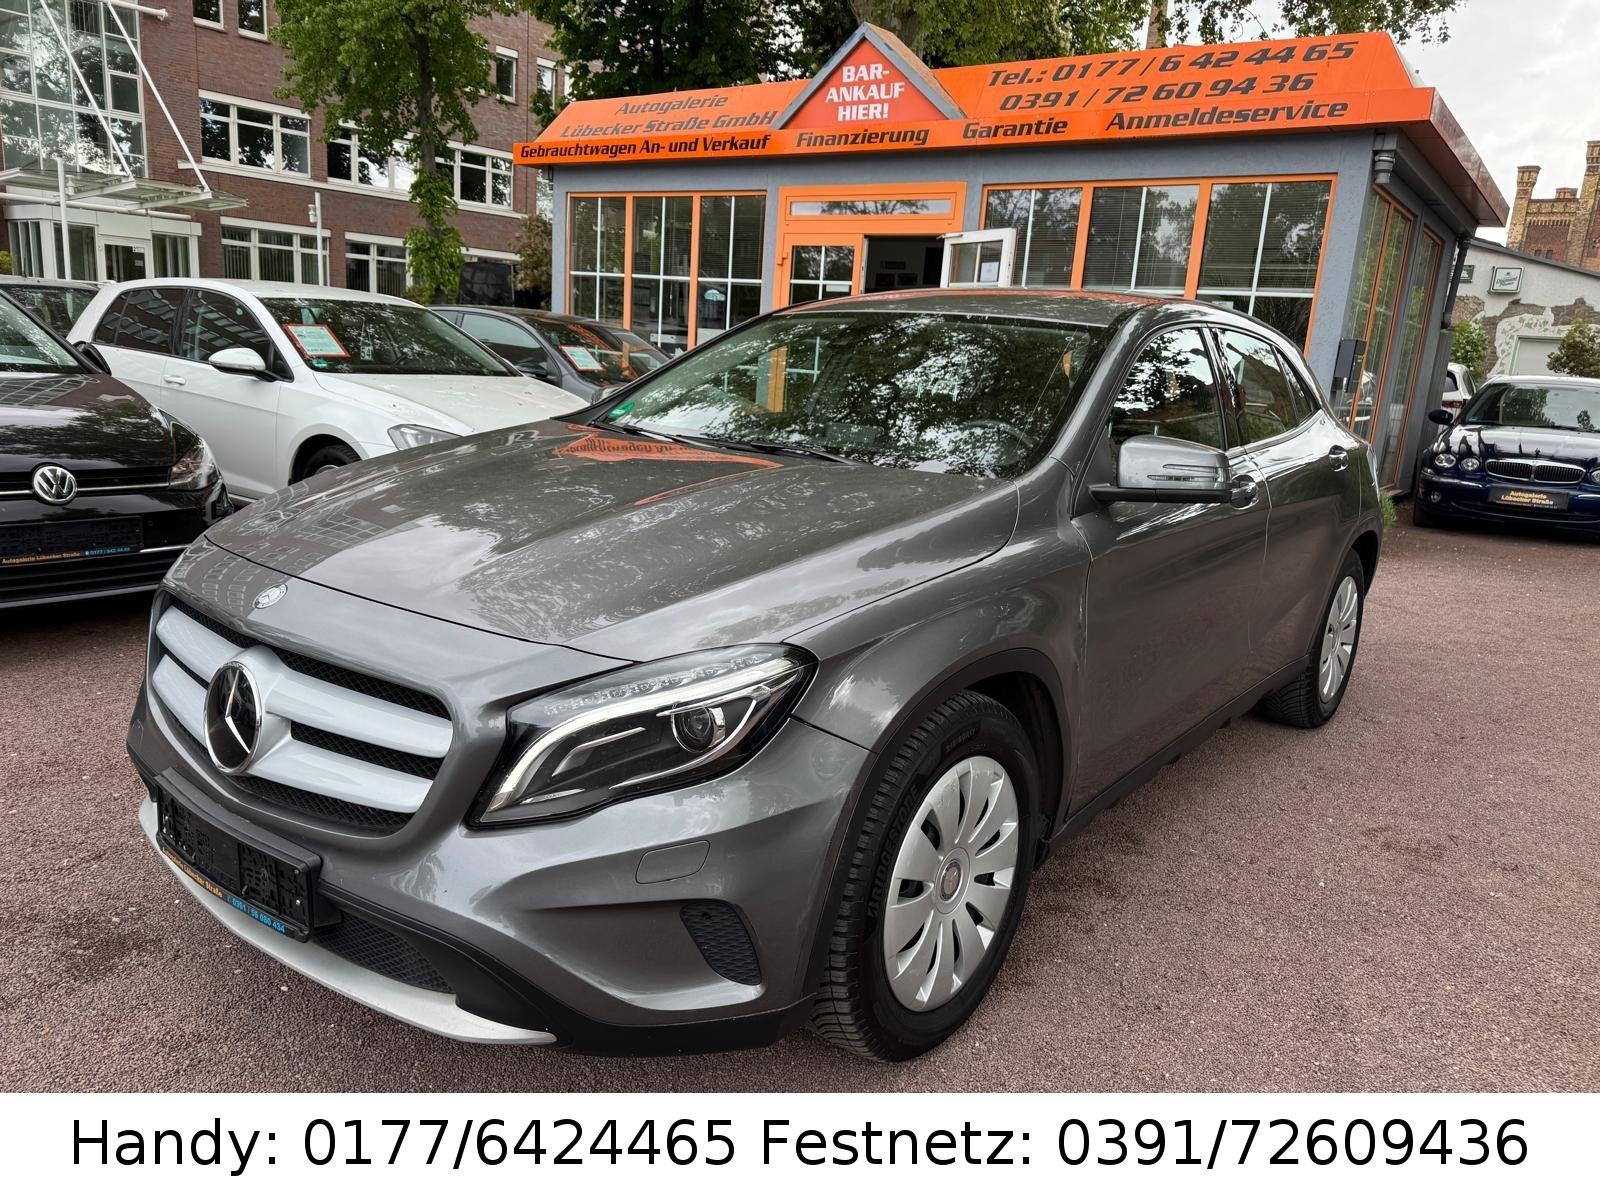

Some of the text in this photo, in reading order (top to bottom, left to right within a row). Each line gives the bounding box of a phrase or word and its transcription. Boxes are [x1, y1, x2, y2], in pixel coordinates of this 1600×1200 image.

[842, 63, 890, 82] BAR-
[989, 69, 1047, 87] Tel.:
[1052, 57, 1139, 83] 0177
[1187, 50, 1240, 69] 42
[1244, 46, 1296, 65] 44
[1301, 40, 1359, 62] 65
[825, 82, 905, 103] ANKAUF
[999, 91, 1079, 111] 0391
[1103, 86, 1147, 104] 72
[1152, 82, 1202, 101] 60
[1204, 77, 1257, 97] 94
[1262, 72, 1317, 93] 36
[614, 94, 728, 116] Autogalerie
[837, 102, 889, 121] HIER!
[1105, 100, 1349, 132] Anmeldeservice
[560, 109, 777, 138] Lübecker Straße GmbH
[962, 117, 1068, 140] Garantie
[520, 134, 771, 159] Gebrauchtwagen An- und Verkauf
[796, 127, 929, 149] Finanzierung
